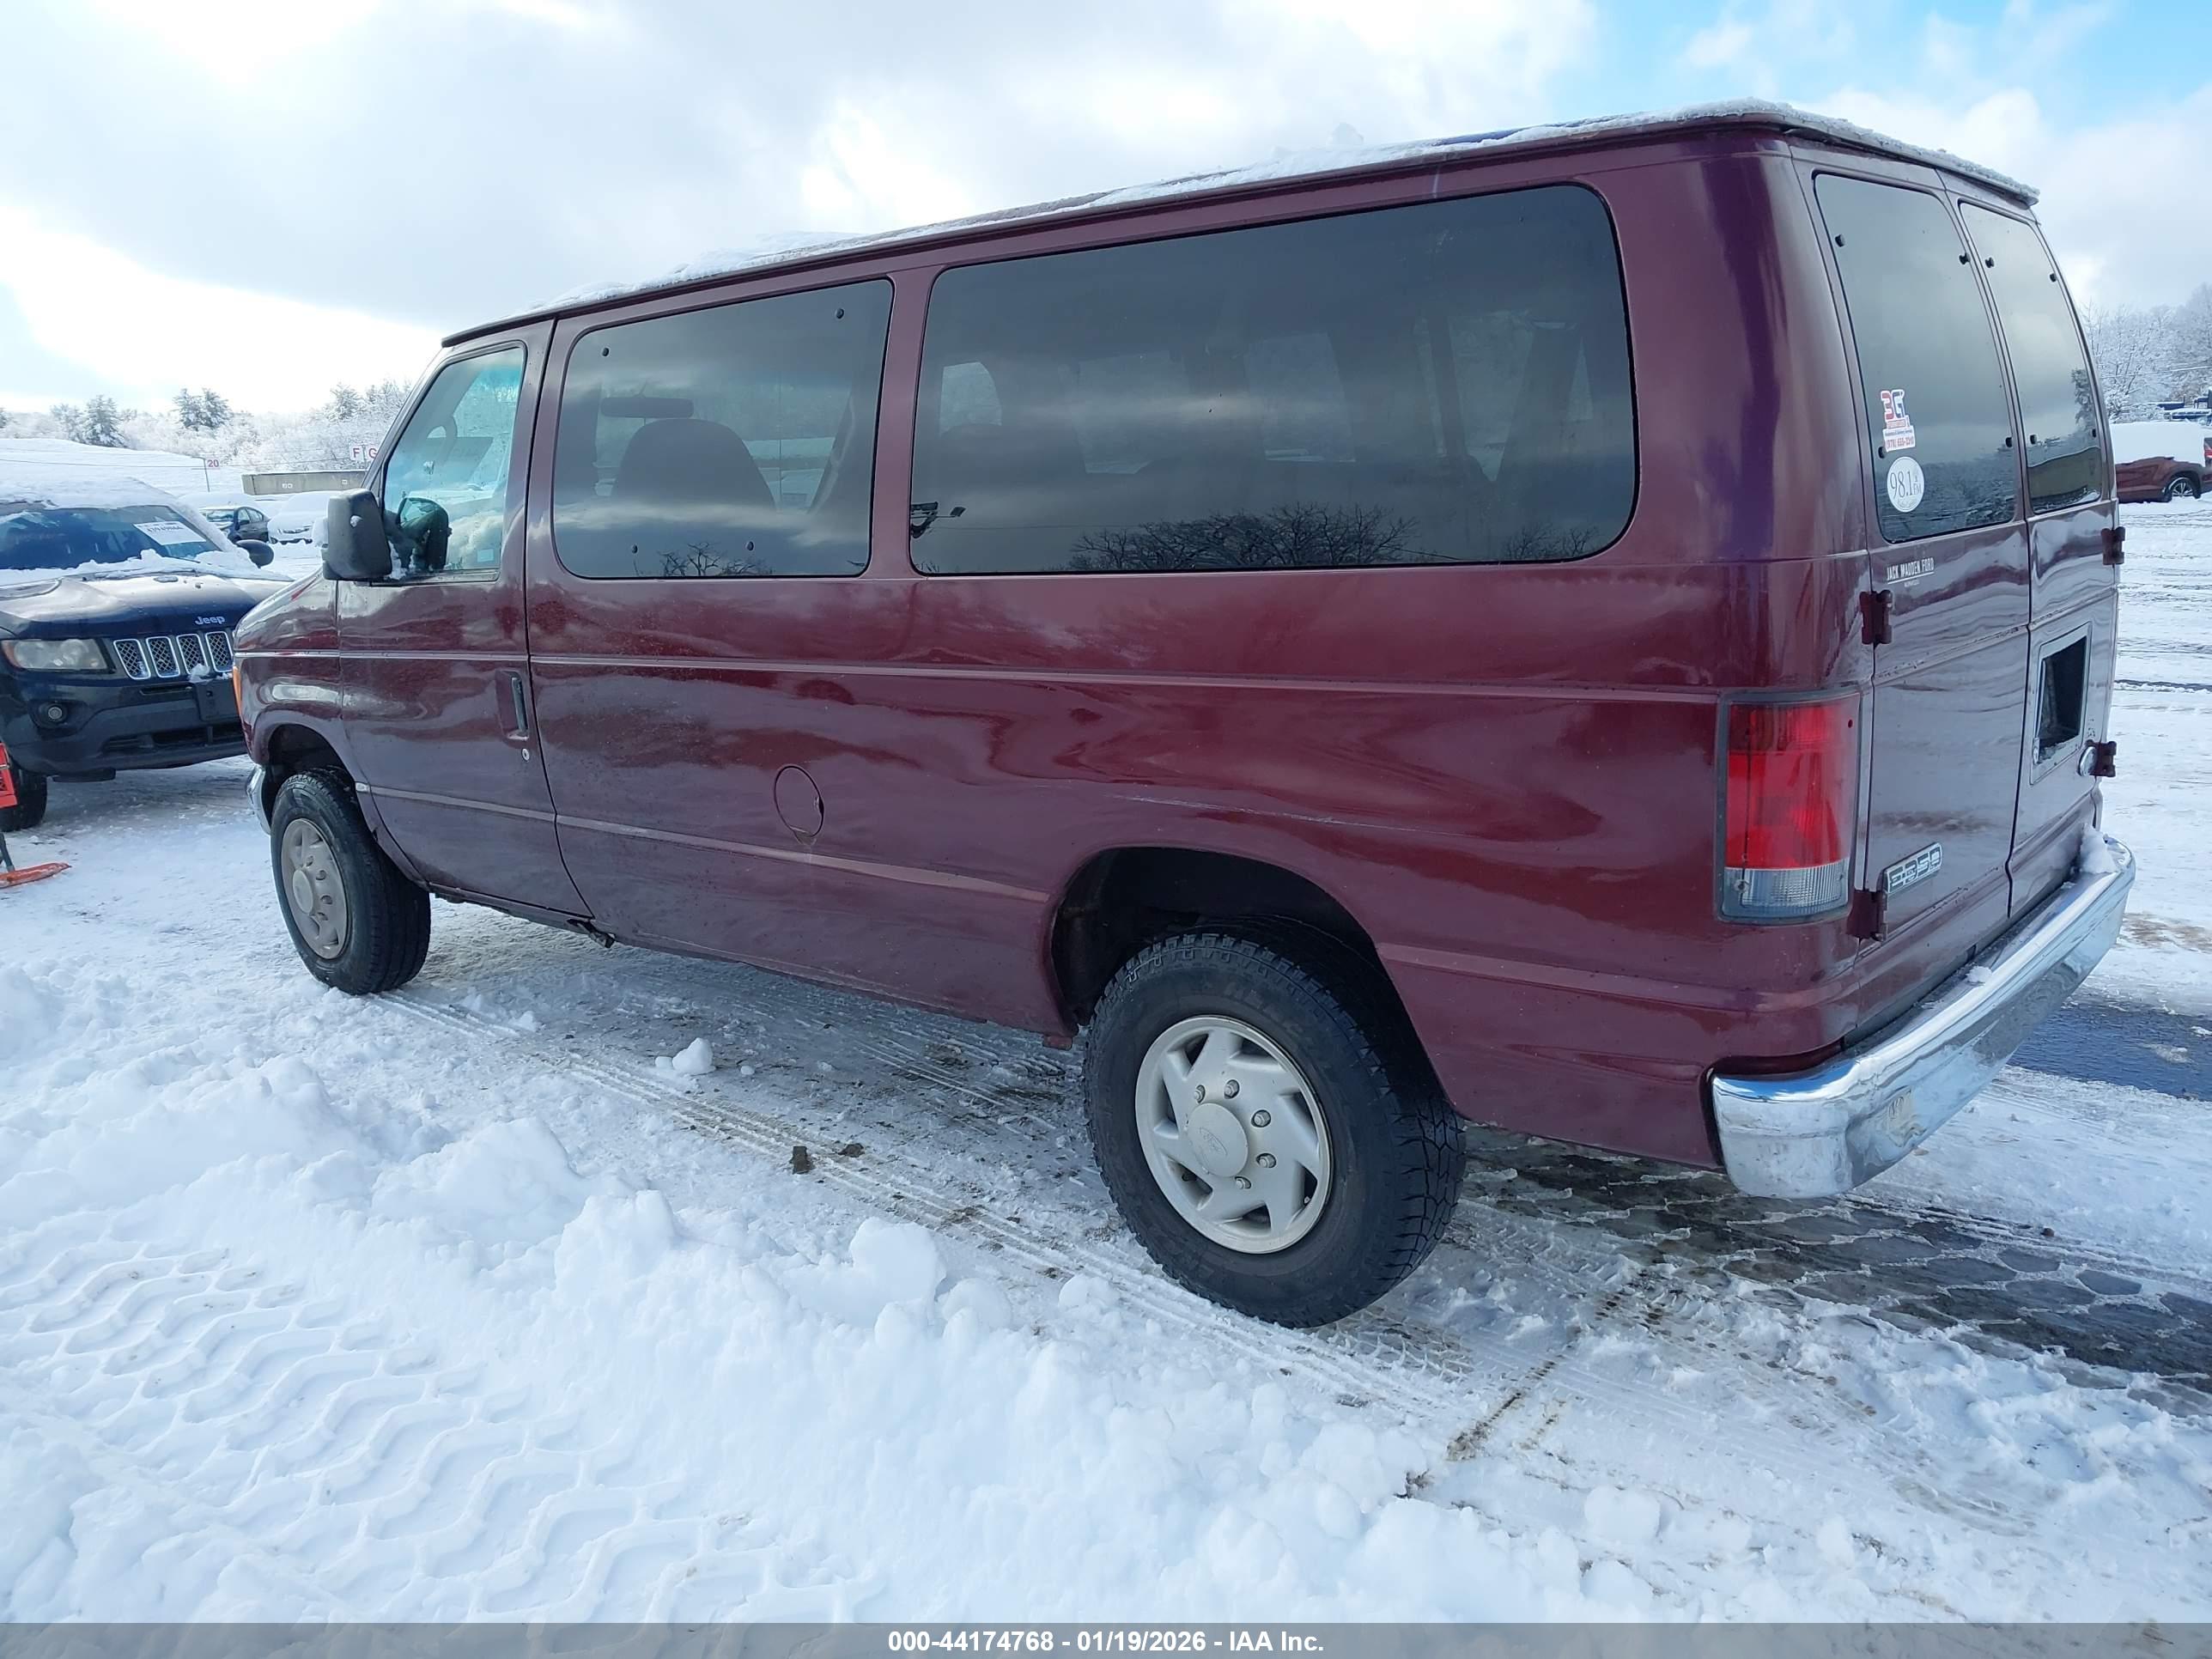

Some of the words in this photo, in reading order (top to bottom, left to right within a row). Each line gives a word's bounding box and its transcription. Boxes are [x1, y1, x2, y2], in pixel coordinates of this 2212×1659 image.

[353, 447, 360, 458] F
[207, 459, 219, 468] 20
[1890, 470, 1912, 499] 98.1
[1887, 565, 1899, 581] JACK
[1900, 560, 1921, 578] MADDEN
[1921, 557, 1935, 573] FORD
[194, 616, 225, 625] Jeep
